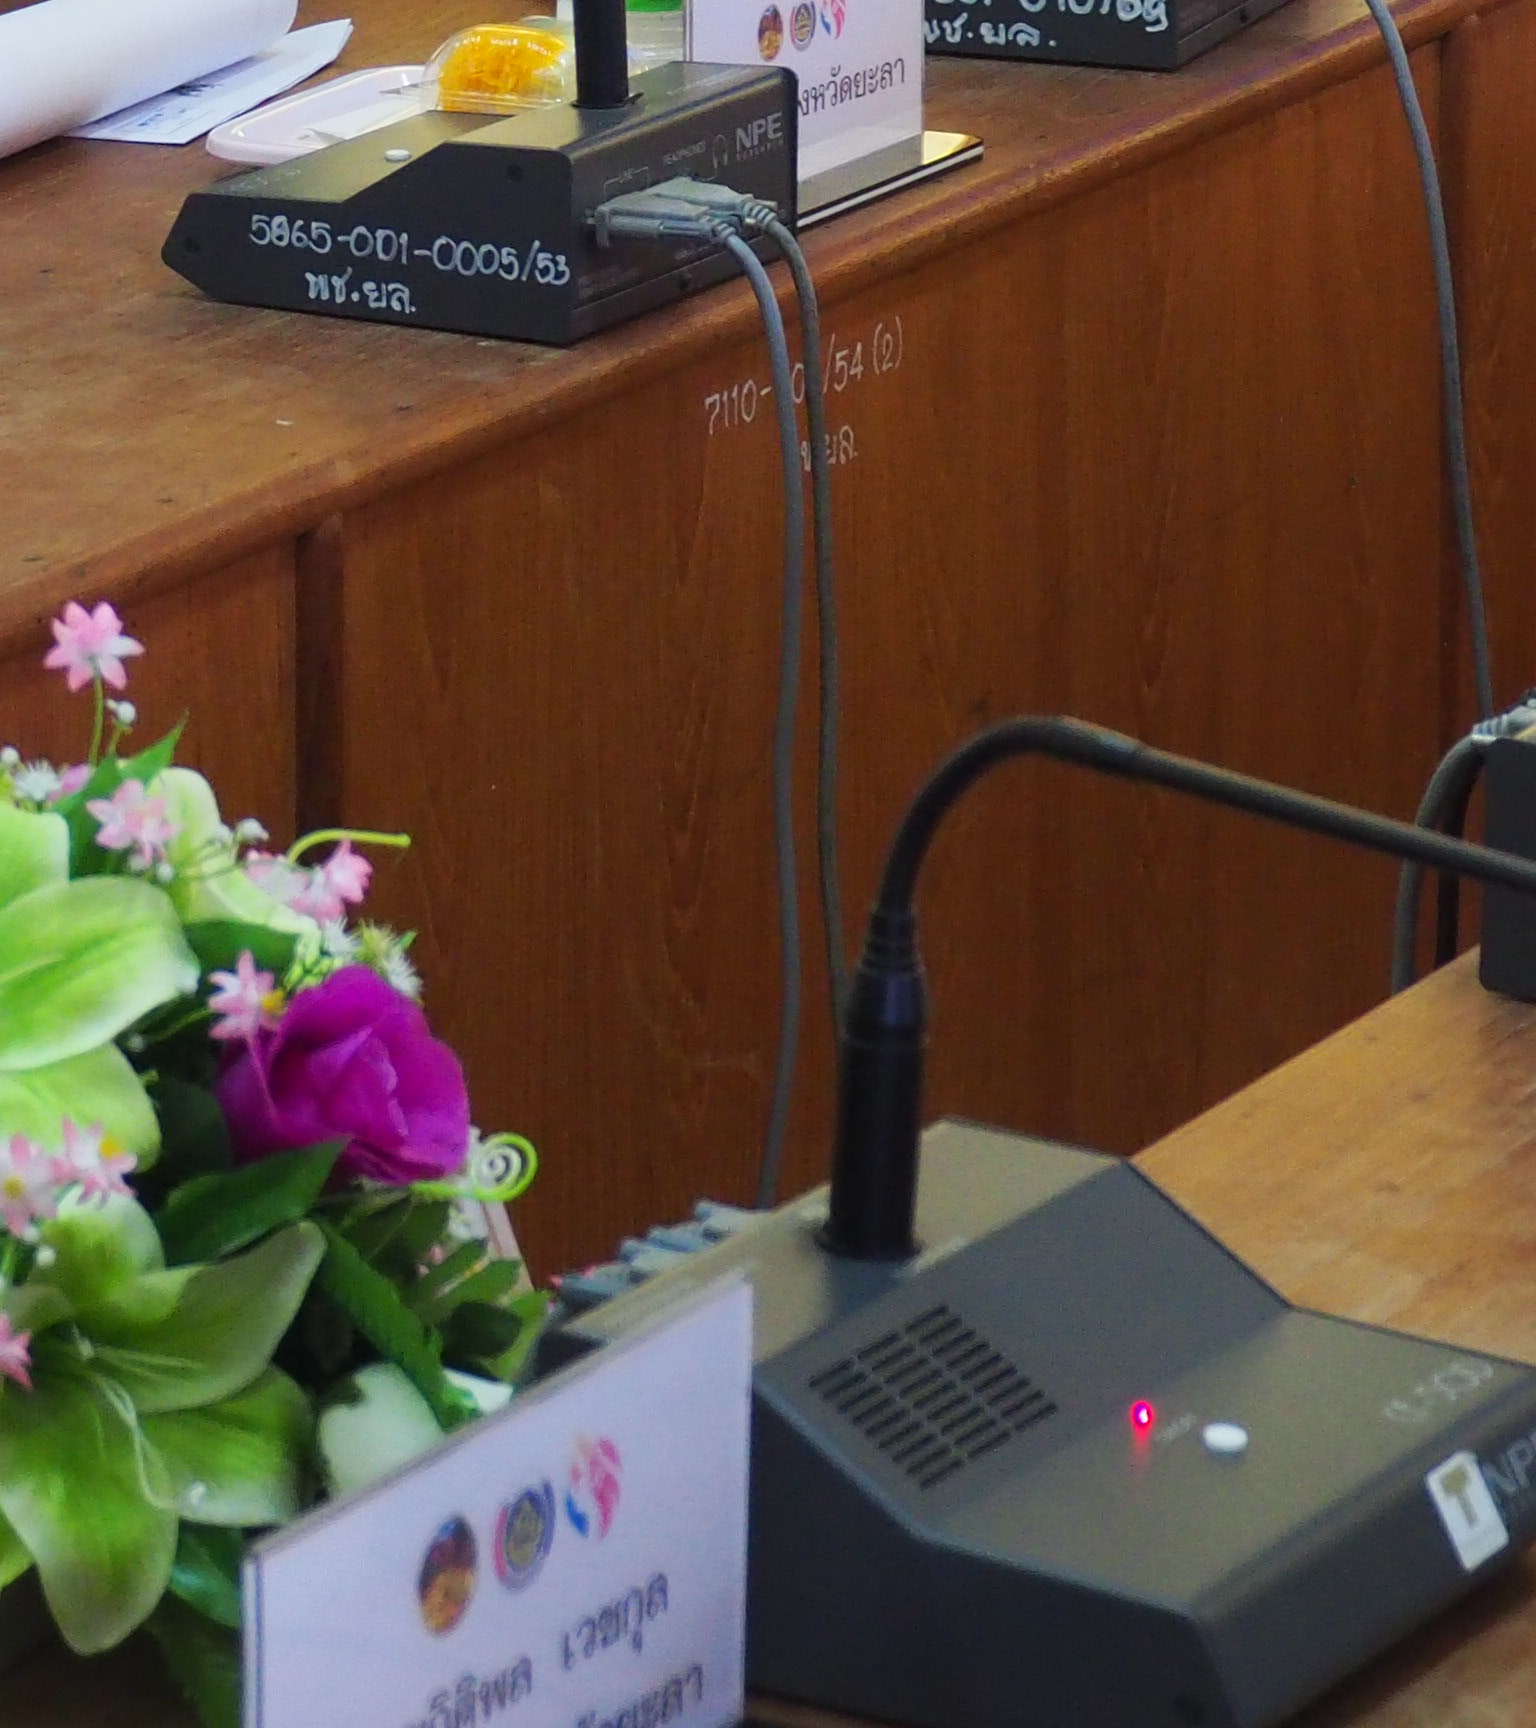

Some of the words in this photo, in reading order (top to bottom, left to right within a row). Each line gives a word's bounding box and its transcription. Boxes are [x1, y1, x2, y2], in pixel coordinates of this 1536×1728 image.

[797, 57, 906, 116] งหวัดยะลา
[735, 111, 784, 150] NPE
[872, 315, 904, 375] (2)
